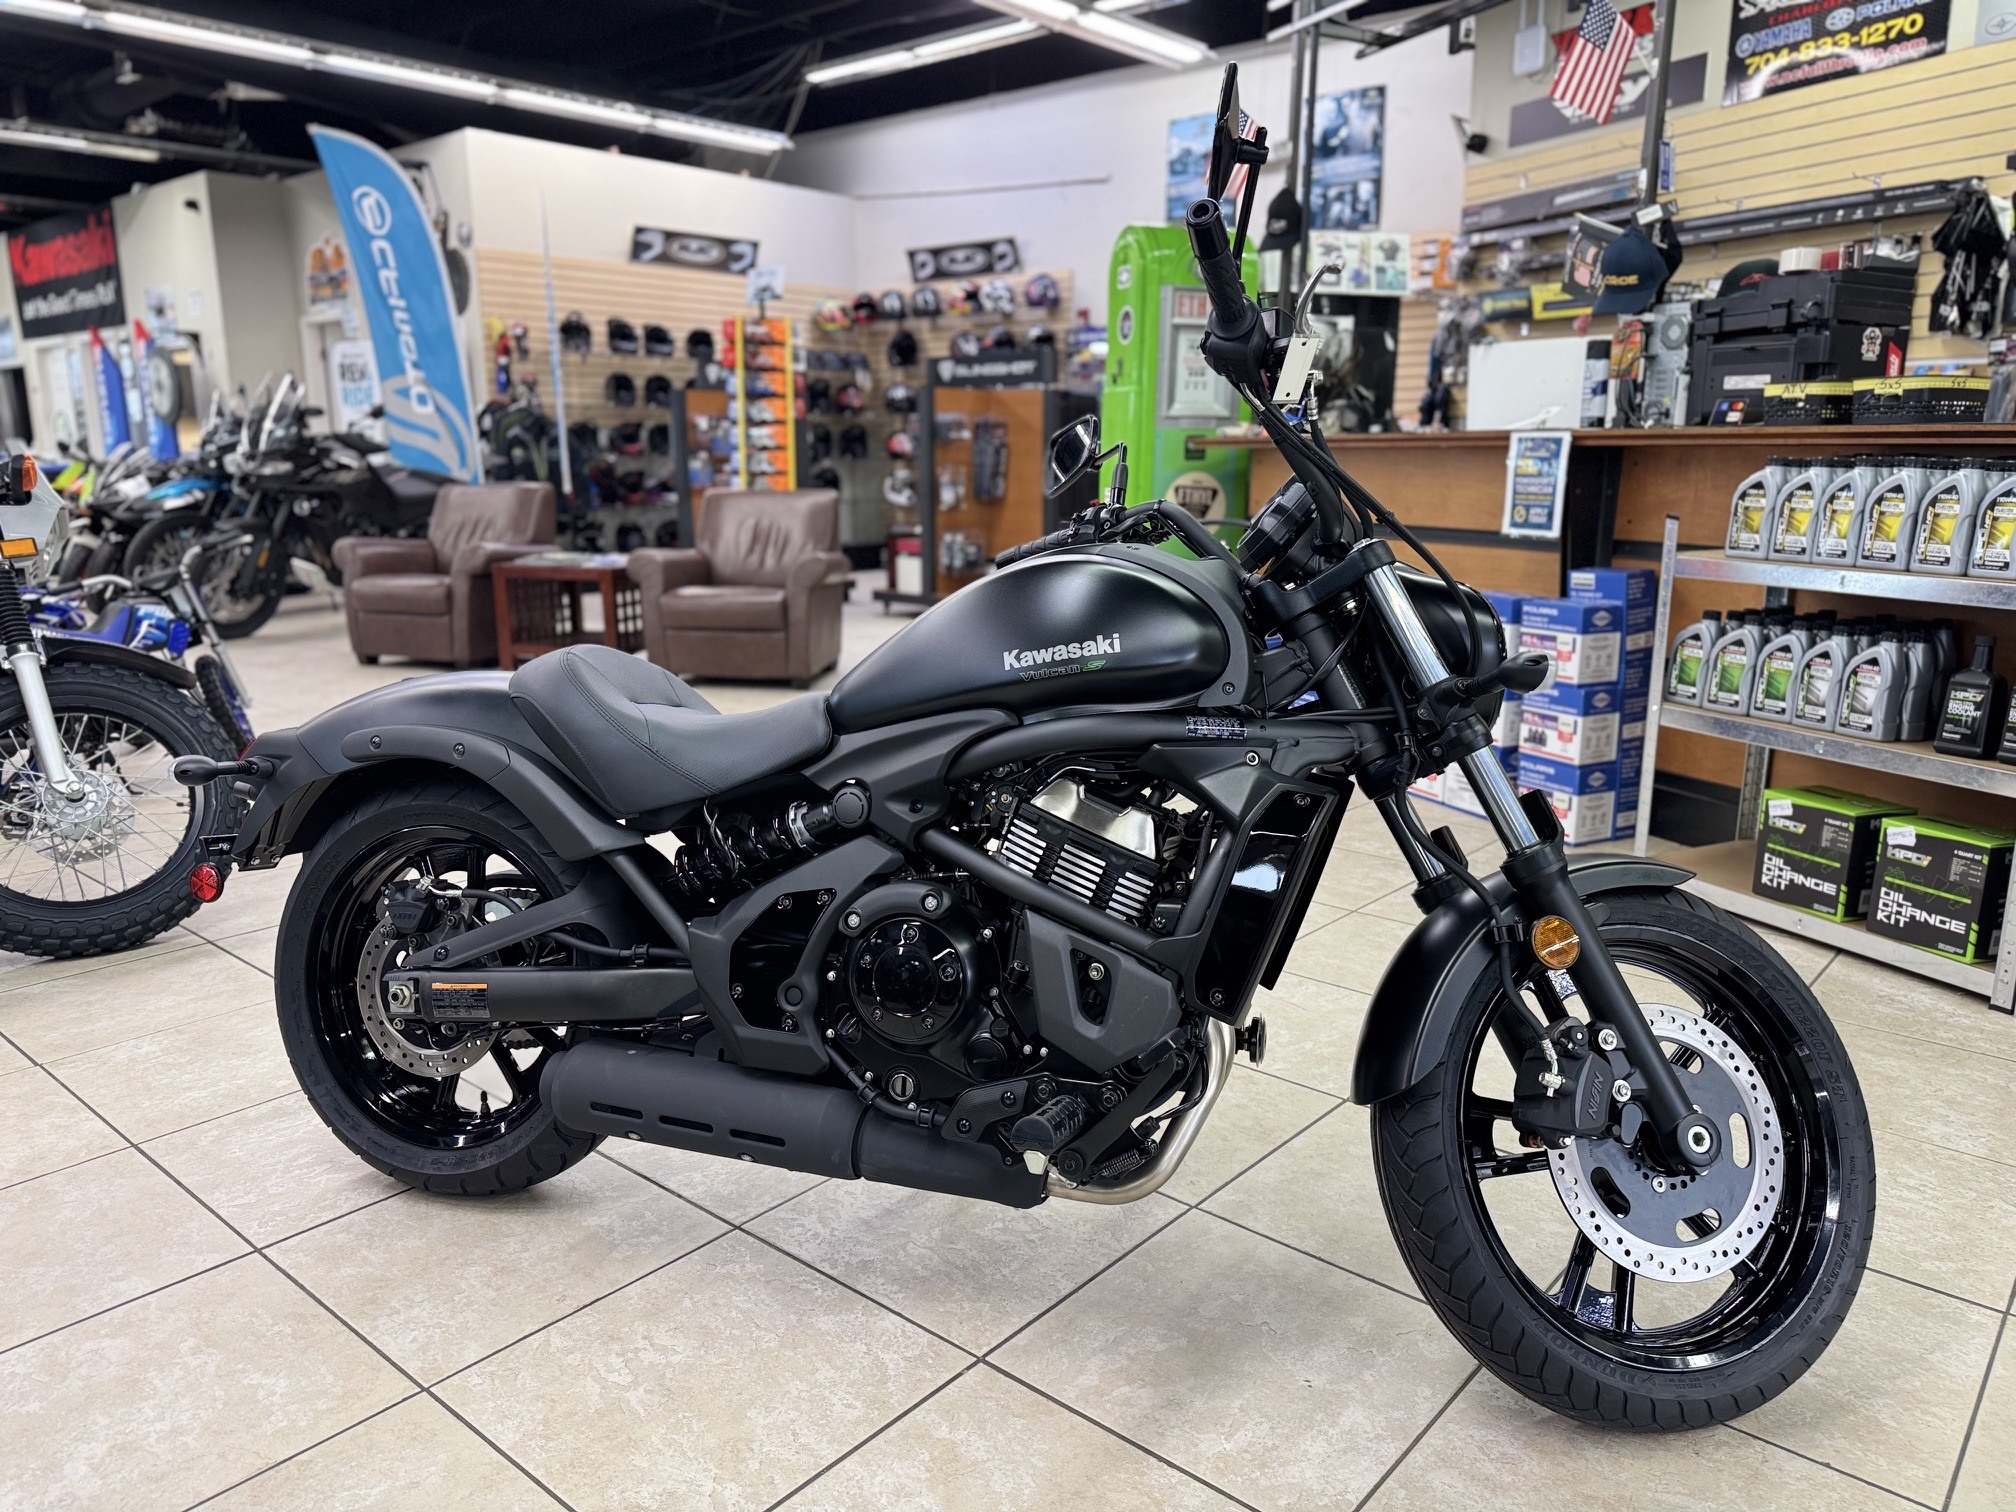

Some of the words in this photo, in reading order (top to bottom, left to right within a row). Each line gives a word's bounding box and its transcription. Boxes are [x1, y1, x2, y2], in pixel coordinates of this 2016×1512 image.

[1744, 12, 1924, 75] 704-833-1270
[1754, 17, 1812, 51] YAMAHA
[8, 208, 116, 287] Kawasaki
[1003, 633, 1121, 671] Kawasaki
[1019, 664, 1081, 682] Vulcan
[1082, 660, 1107, 672] S
[1947, 708, 1982, 717] COOLANT
[1948, 701, 1975, 711] ENGINE
[1764, 852, 1791, 871] OIL
[1761, 873, 1789, 891] KIT
[1762, 863, 1837, 896] CHANGE
[1879, 886, 1912, 907] OIL
[1876, 909, 1910, 928] KIT
[1877, 899, 1967, 935] CHANGE
[1533, 1321, 1637, 1386] DUNLOP
